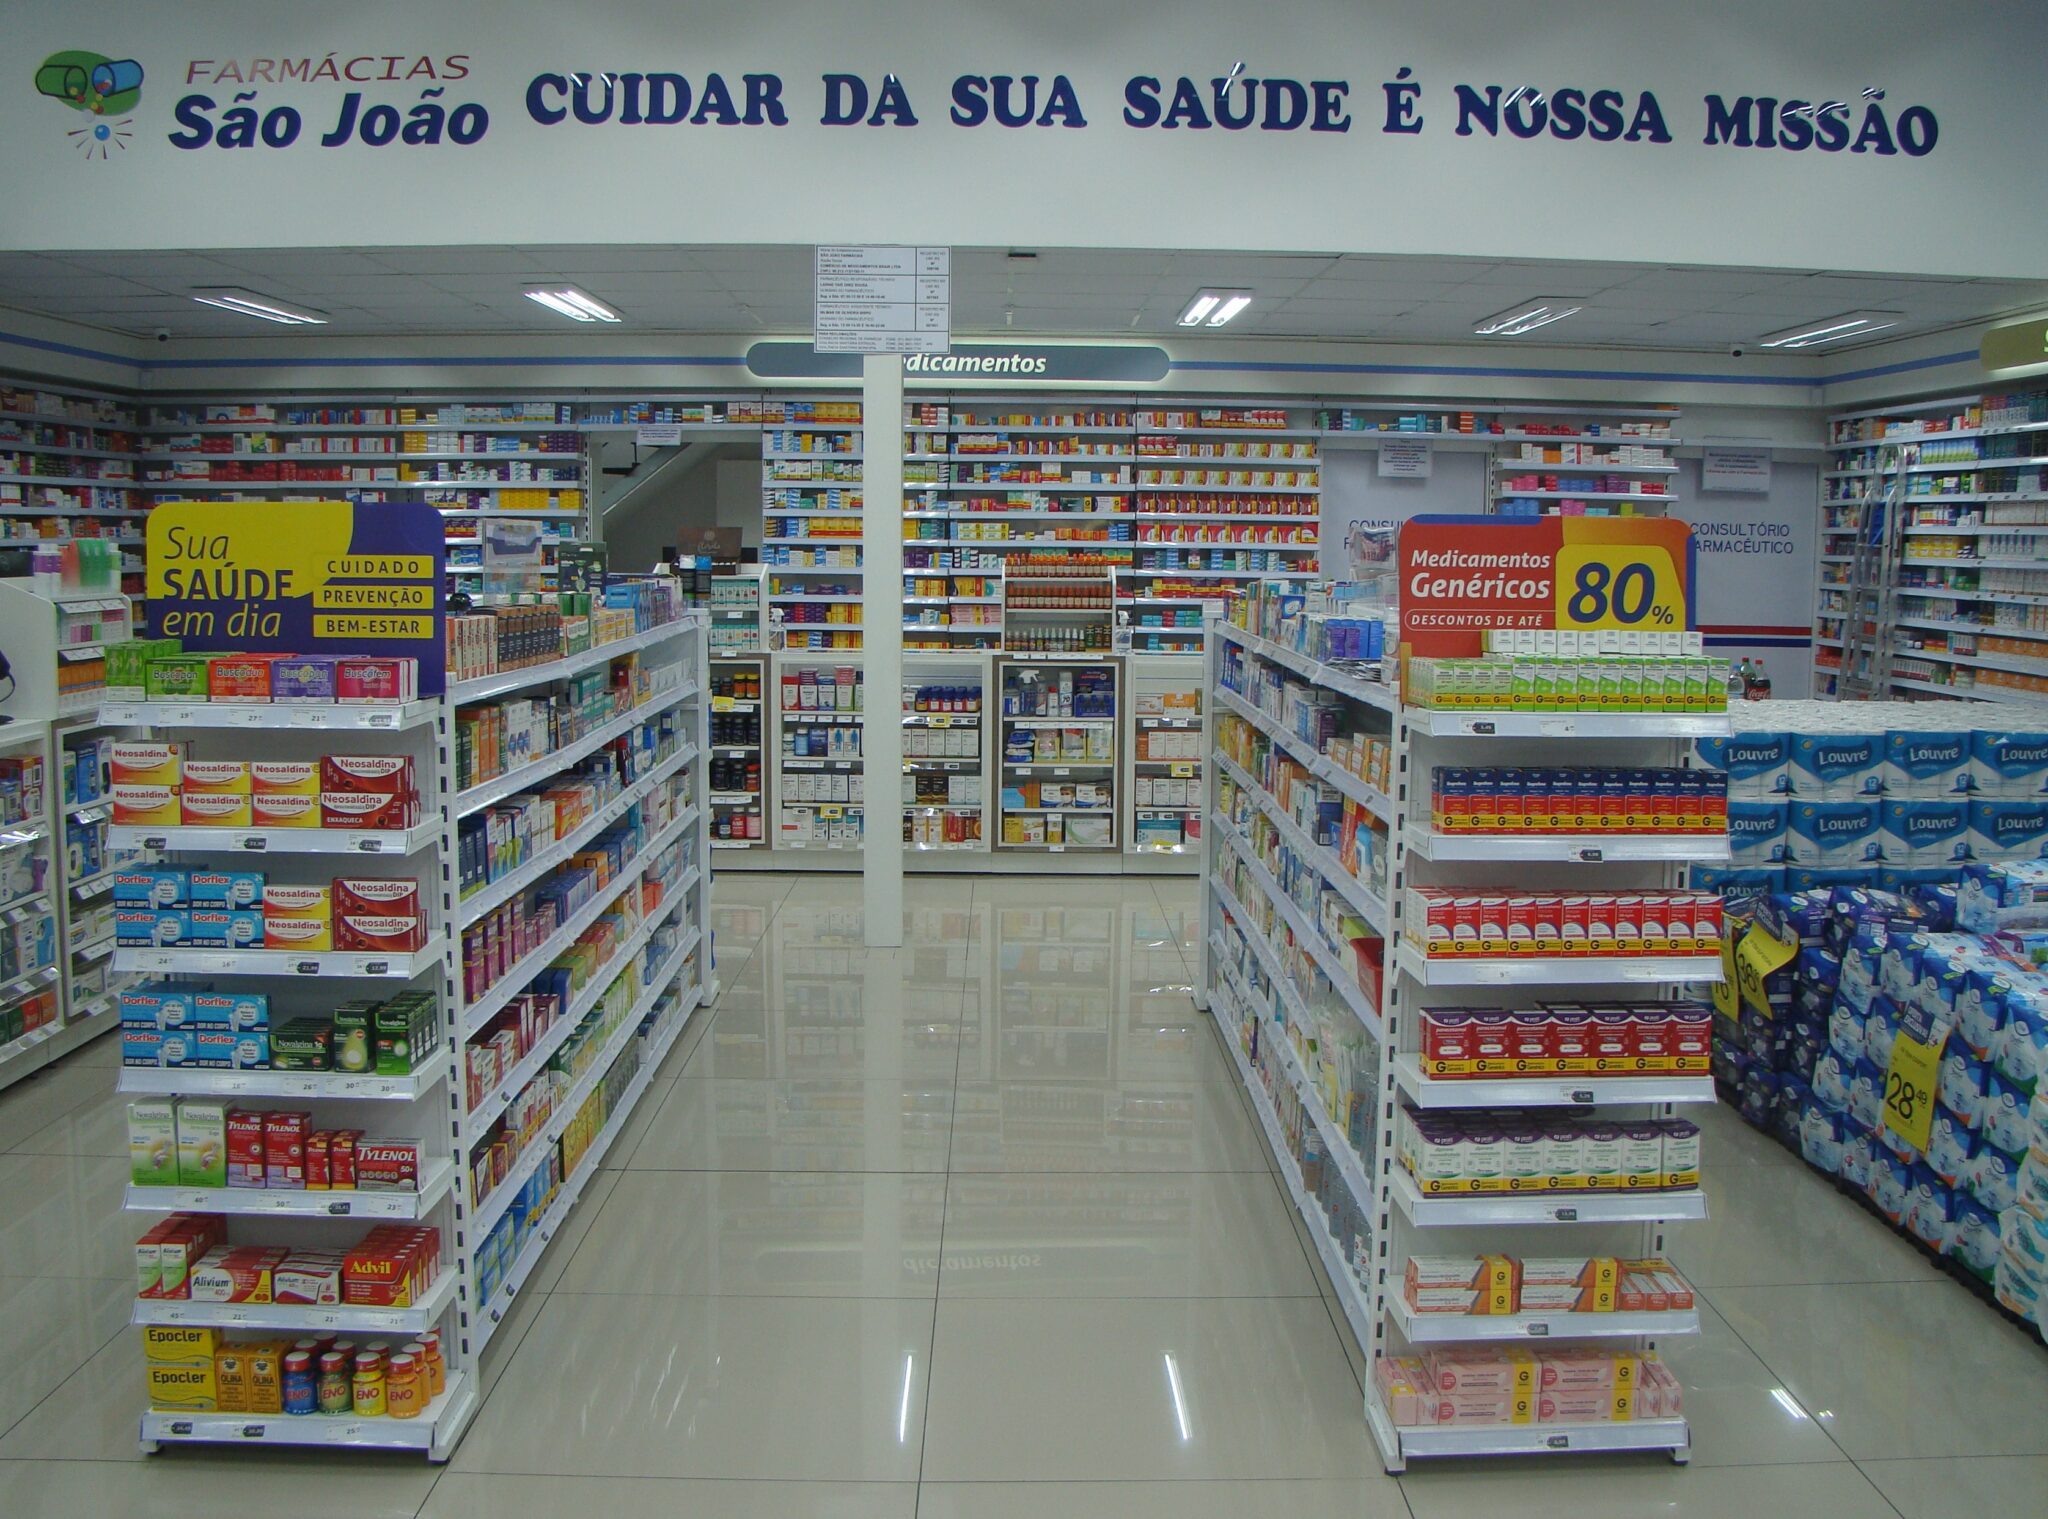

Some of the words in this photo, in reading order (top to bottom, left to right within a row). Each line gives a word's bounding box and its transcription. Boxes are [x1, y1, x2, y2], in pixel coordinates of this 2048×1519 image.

[186, 53, 470, 84] FARMÁCIAS
[526, 72, 788, 126] CUIDAR
[820, 73, 918, 127] DA
[950, 73, 1088, 128] SUA
[1123, 62, 1352, 133] SAÚDE
[1382, 67, 1423, 134] É
[1454, 84, 1673, 144] NOSSA
[1703, 86, 1940, 157] MISSÃO
[167, 90, 301, 150] São
[320, 86, 489, 148] João
[904, 353, 1047, 374] dicamentos
[1690, 522, 1790, 537] CONSULTÓRIO
[164, 526, 229, 560] Sua
[1696, 539, 1794, 554] ARMACÊUTICO
[1411, 550, 1550, 568] Medicamentos
[327, 560, 420, 574] CUIDADO
[164, 562, 293, 600] SAÚDE
[1410, 572, 1550, 599] Genéricos
[323, 587, 424, 607] PREVENÇÃO
[163, 611, 214, 636] em
[227, 603, 281, 637] dia
[1411, 614, 1491, 626] DESCONTOS
[1497, 615, 1513, 626] DE
[1519, 613, 1543, 626] ATÉ
[326, 620, 420, 634] BEM-ESTAR
[153, 669, 198, 681] Buscopan
[280, 668, 328, 681] Buscopan
[344, 668, 391, 680] Buscofem
[115, 749, 168, 759] Neosaldina
[1728, 748, 1778, 762] Louvre
[1819, 750, 1868, 765] Louvre
[1909, 747, 1959, 761] Louvre
[2001, 748, 2048, 761] Louvre
[187, 763, 241, 774] Neosaldina
[256, 764, 311, 774] Neosaldina
[340, 759, 397, 769] Neosaldina
[115, 790, 170, 800] Neosaldina
[323, 794, 382, 805] Neosaldina
[186, 796, 241, 806] Neosaldina
[257, 797, 311, 807] Neosaldina
[1819, 818, 1867, 831] Louvre
[1909, 816, 1957, 830] Louvre
[1998, 817, 2044, 831] Louvre
[116, 875, 152, 884] Dorflex
[192, 874, 230, 884] Dorflex
[352, 883, 408, 892] Neosaldina
[267, 889, 321, 899] Neosaldina
[118, 913, 155, 922] Dorflex
[192, 913, 230, 922] Dorflex
[268, 921, 321, 931] Neosaldina
[353, 919, 409, 927] Neosaldina
[1428, 942, 1438, 951] G
[1455, 942, 1464, 951] G
[1482, 941, 1491, 950] G
[1510, 941, 1519, 950] G
[1536, 940, 1545, 949] G
[1564, 941, 1573, 950] G
[1591, 940, 1599, 949] G
[1617, 940, 1626, 949] G
[1643, 940, 1652, 949] G
[1670, 940, 1678, 949] G
[1696, 939, 1705, 948] G
[122, 996, 160, 1005] Dorflex
[196, 998, 233, 1007] Dorflex
[125, 1033, 162, 1042] Dorflex
[200, 1035, 237, 1044] Dorflex
[1436, 1062, 1446, 1072] G
[1477, 1060, 1486, 1070] G
[1517, 1060, 1527, 1070] G
[1557, 1060, 1566, 1070] G
[1597, 1059, 1606, 1069] G
[1636, 1058, 1646, 1068] G
[1676, 1058, 1686, 1068] G
[1887, 1072, 1914, 1119] 28
[228, 1121, 262, 1131] TYLENOL
[267, 1123, 301, 1133] TYLENOL
[359, 1147, 415, 1162] TYLENOL
[1510, 1178, 1520, 1189] G
[1549, 1177, 1558, 1187] G
[1588, 1176, 1597, 1186] G
[1628, 1175, 1637, 1185] G
[1670, 1174, 1678, 1184] G
[1430, 1181, 1440, 1191] G
[1470, 1179, 1480, 1190] G
[351, 1261, 391, 1274] Advil
[1497, 1272, 1505, 1281] G
[1602, 1270, 1610, 1279] G
[193, 1277, 229, 1287] Alivium
[1497, 1296, 1505, 1305] G
[1600, 1294, 1608, 1303] G
[149, 1329, 202, 1342] Epocler
[1519, 1371, 1529, 1381] G
[1620, 1367, 1628, 1377] G
[153, 1371, 206, 1384] Epocler
[287, 1389, 312, 1399] ENO
[323, 1385, 345, 1399] ENO
[357, 1388, 380, 1399] ENO
[390, 1389, 413, 1400] ENO
[1517, 1401, 1526, 1411] G
[1617, 1399, 1626, 1408] G
